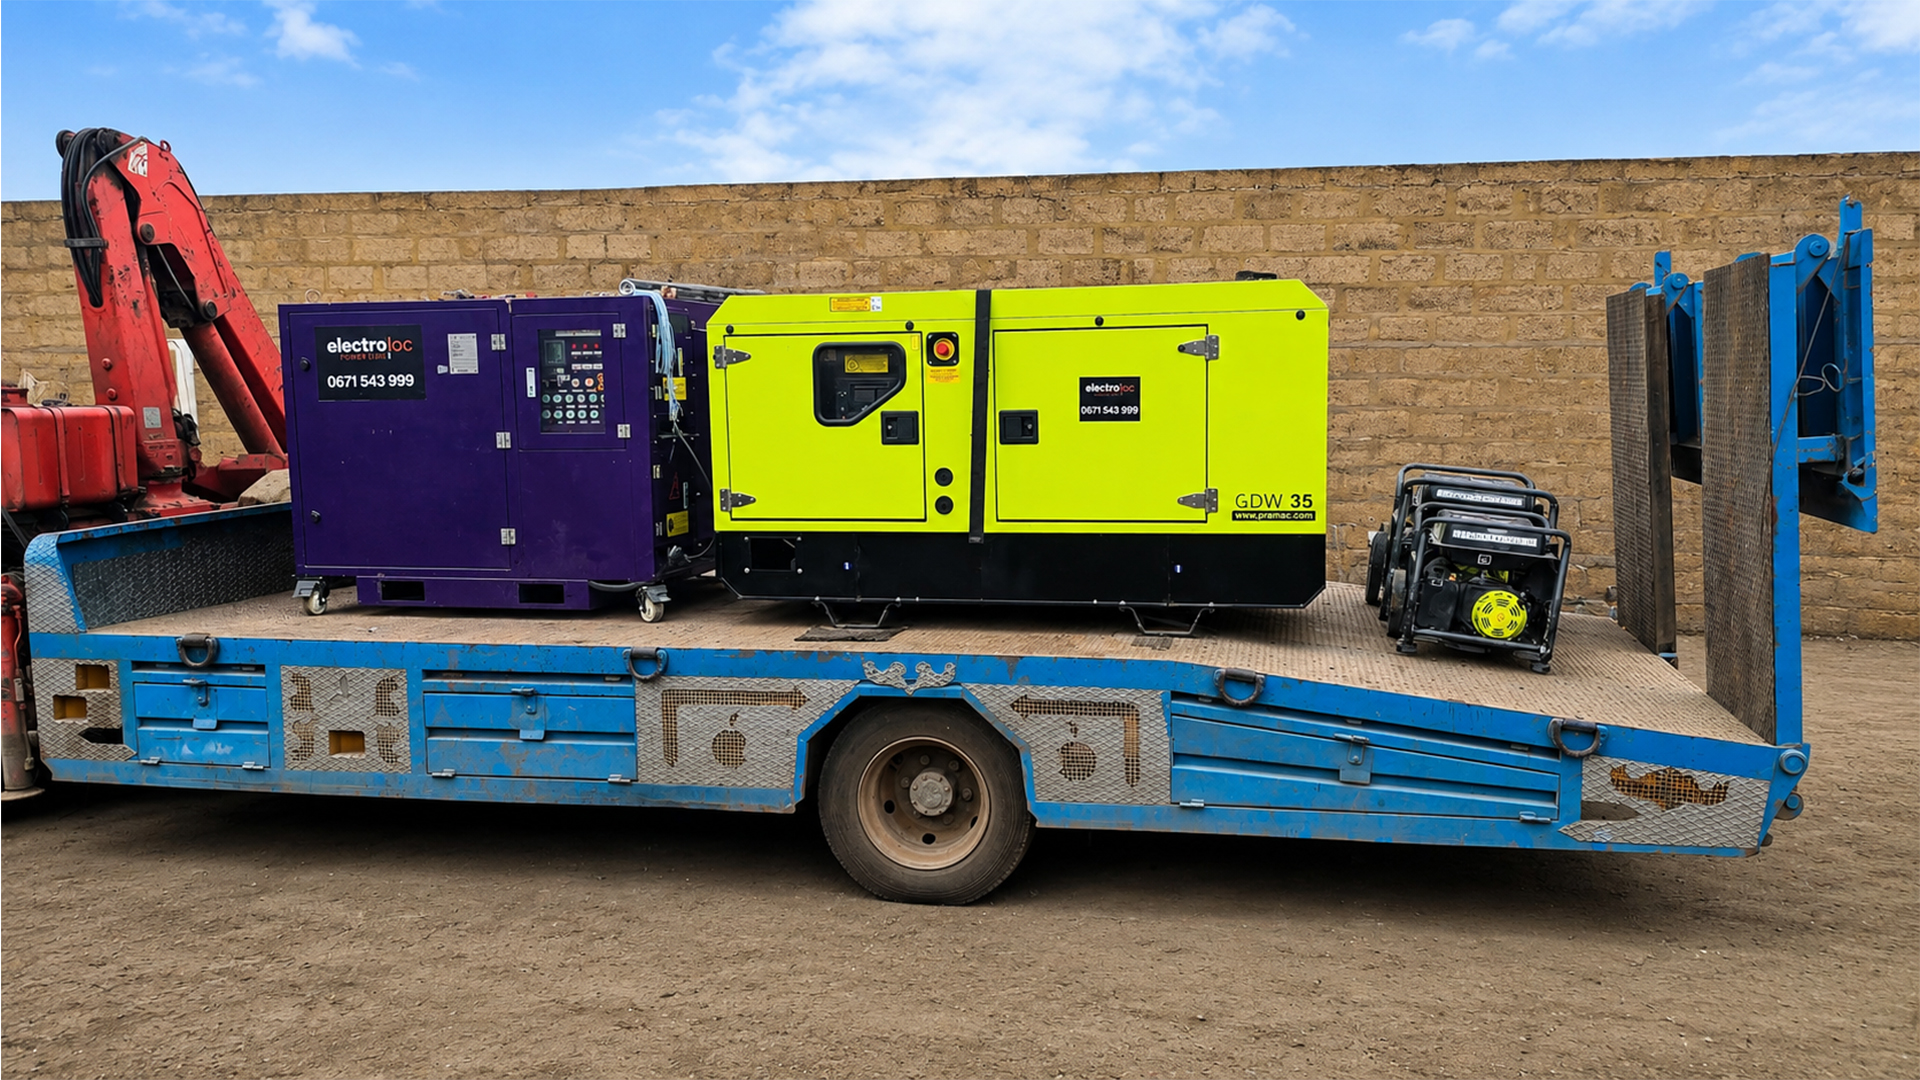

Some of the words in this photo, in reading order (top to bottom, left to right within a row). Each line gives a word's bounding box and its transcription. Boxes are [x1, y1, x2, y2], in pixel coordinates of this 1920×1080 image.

[327, 337, 412, 353] electroloc
[328, 375, 357, 388] 0671
[361, 375, 385, 387] 543
[388, 374, 414, 386] 999
[1081, 406, 1101, 415] 0671
[1103, 406, 1119, 415] 543
[1121, 406, 1138, 415] 999
[1235, 493, 1283, 509] GDW
[1290, 494, 1313, 509] 35
[1234, 512, 1313, 520] www.pramac.com
